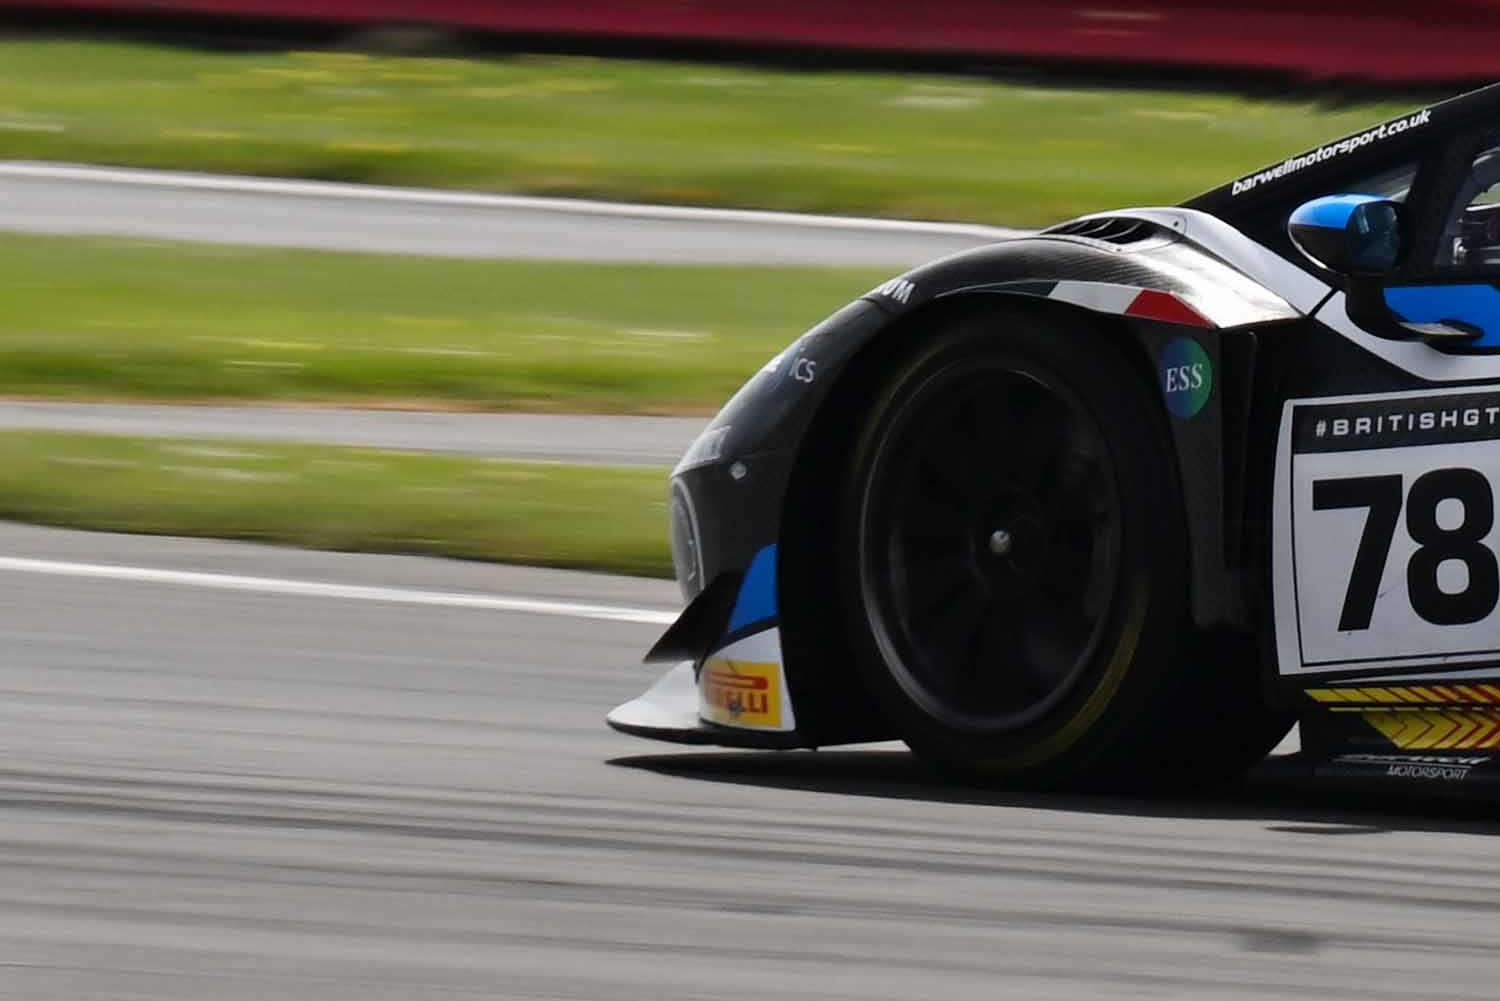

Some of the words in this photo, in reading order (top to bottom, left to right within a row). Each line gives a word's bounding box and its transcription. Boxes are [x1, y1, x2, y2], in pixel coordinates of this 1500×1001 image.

[1231, 110, 1431, 196] barwellmotorsport.co.uk
[1166, 363, 1203, 393] ESS
[1315, 407, 1500, 438] #BRITISHGT
[1312, 467, 1500, 632] 78
[1386, 764, 1471, 780] MOTORSPORT
